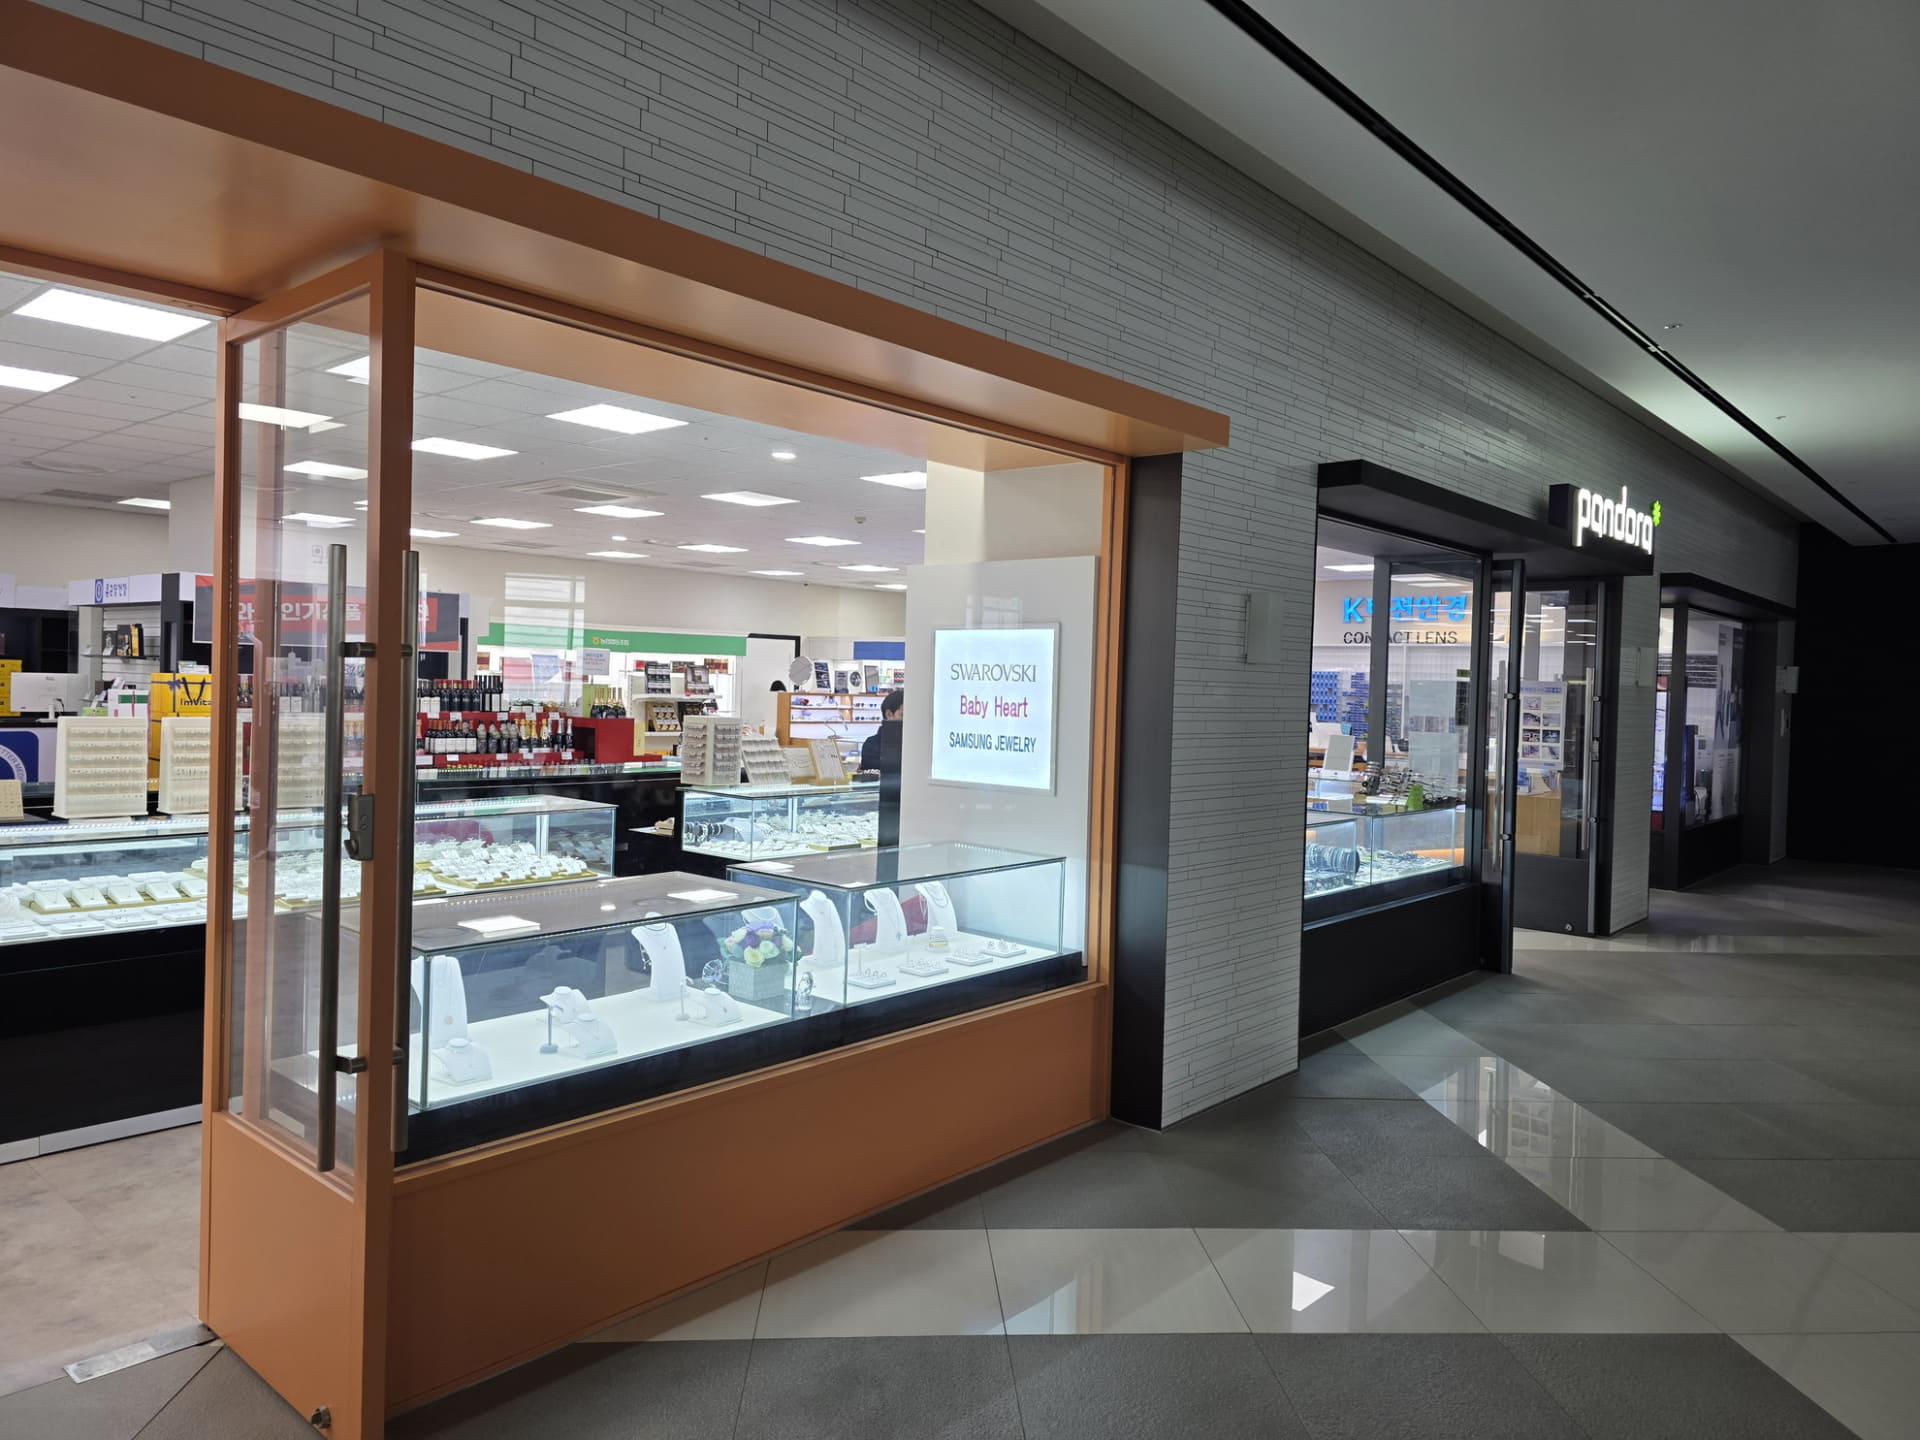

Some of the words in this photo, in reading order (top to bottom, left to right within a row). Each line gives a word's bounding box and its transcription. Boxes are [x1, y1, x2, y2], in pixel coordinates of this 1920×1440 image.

[1576, 485, 1653, 555] pandora
[1343, 631, 1413, 645] CONCT
[1416, 631, 1458, 645] LENS
[950, 663, 1037, 683] SWAROVSKI
[960, 695, 988, 719] Baby
[994, 696, 1029, 718] Heart
[949, 731, 993, 750] SAMSUNG
[995, 735, 1037, 753] JEWELRY
